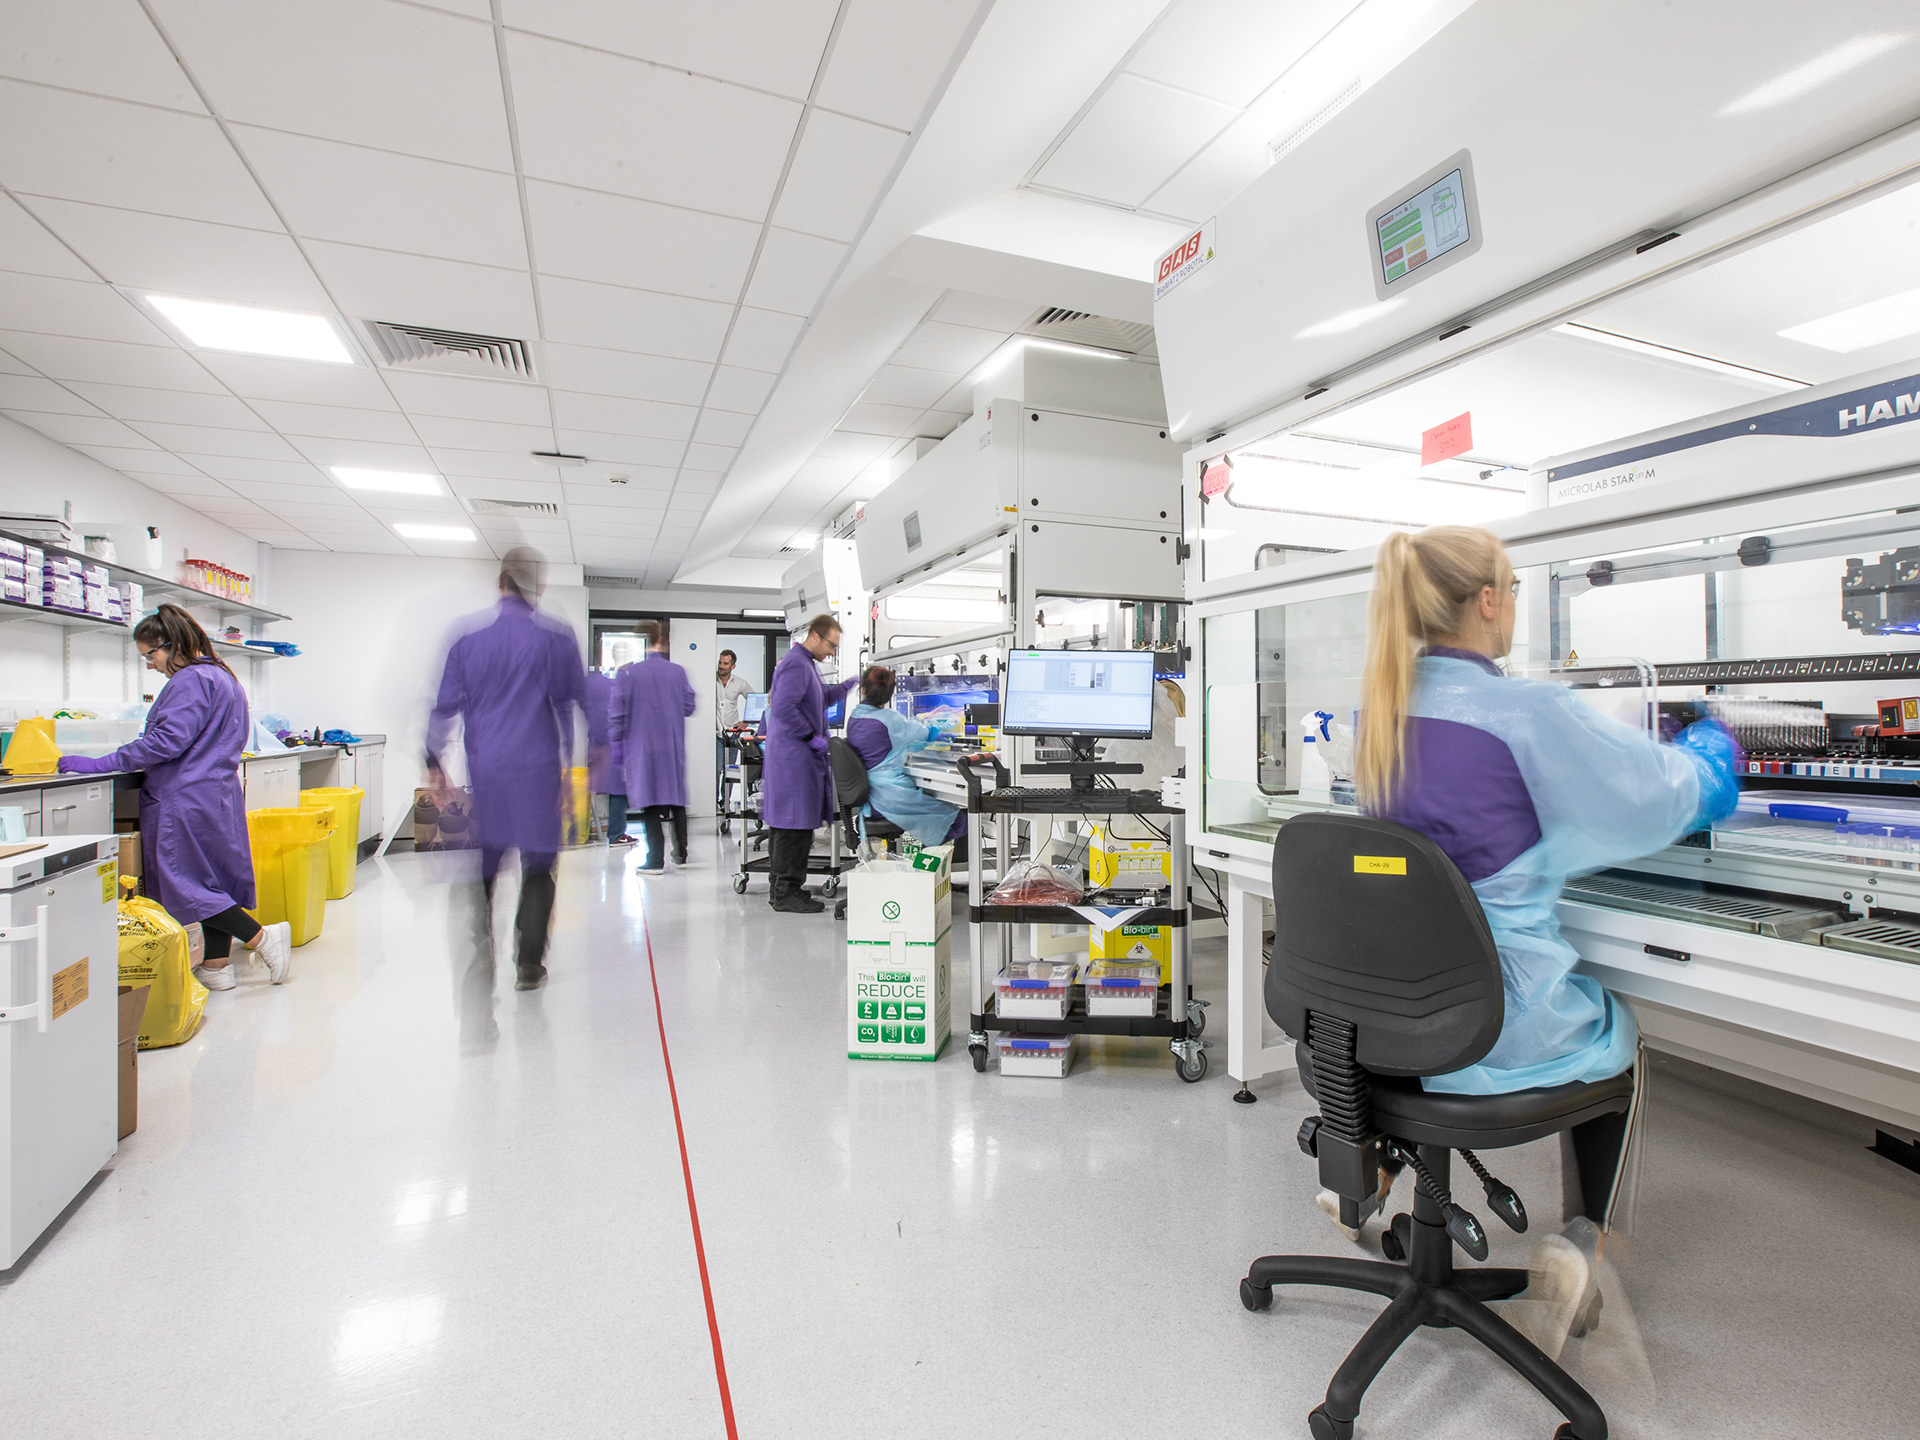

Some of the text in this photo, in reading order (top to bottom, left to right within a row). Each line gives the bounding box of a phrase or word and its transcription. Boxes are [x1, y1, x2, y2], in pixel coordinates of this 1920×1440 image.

[1160, 234, 1199, 279] CAS
[1179, 253, 1205, 278] ROBOTIC
[1839, 390, 1920, 431] HAM
[1558, 479, 1608, 499] MICROLAB
[1833, 767, 1840, 775] E
[858, 973, 875, 981] This
[858, 983, 926, 998] REDUCE
